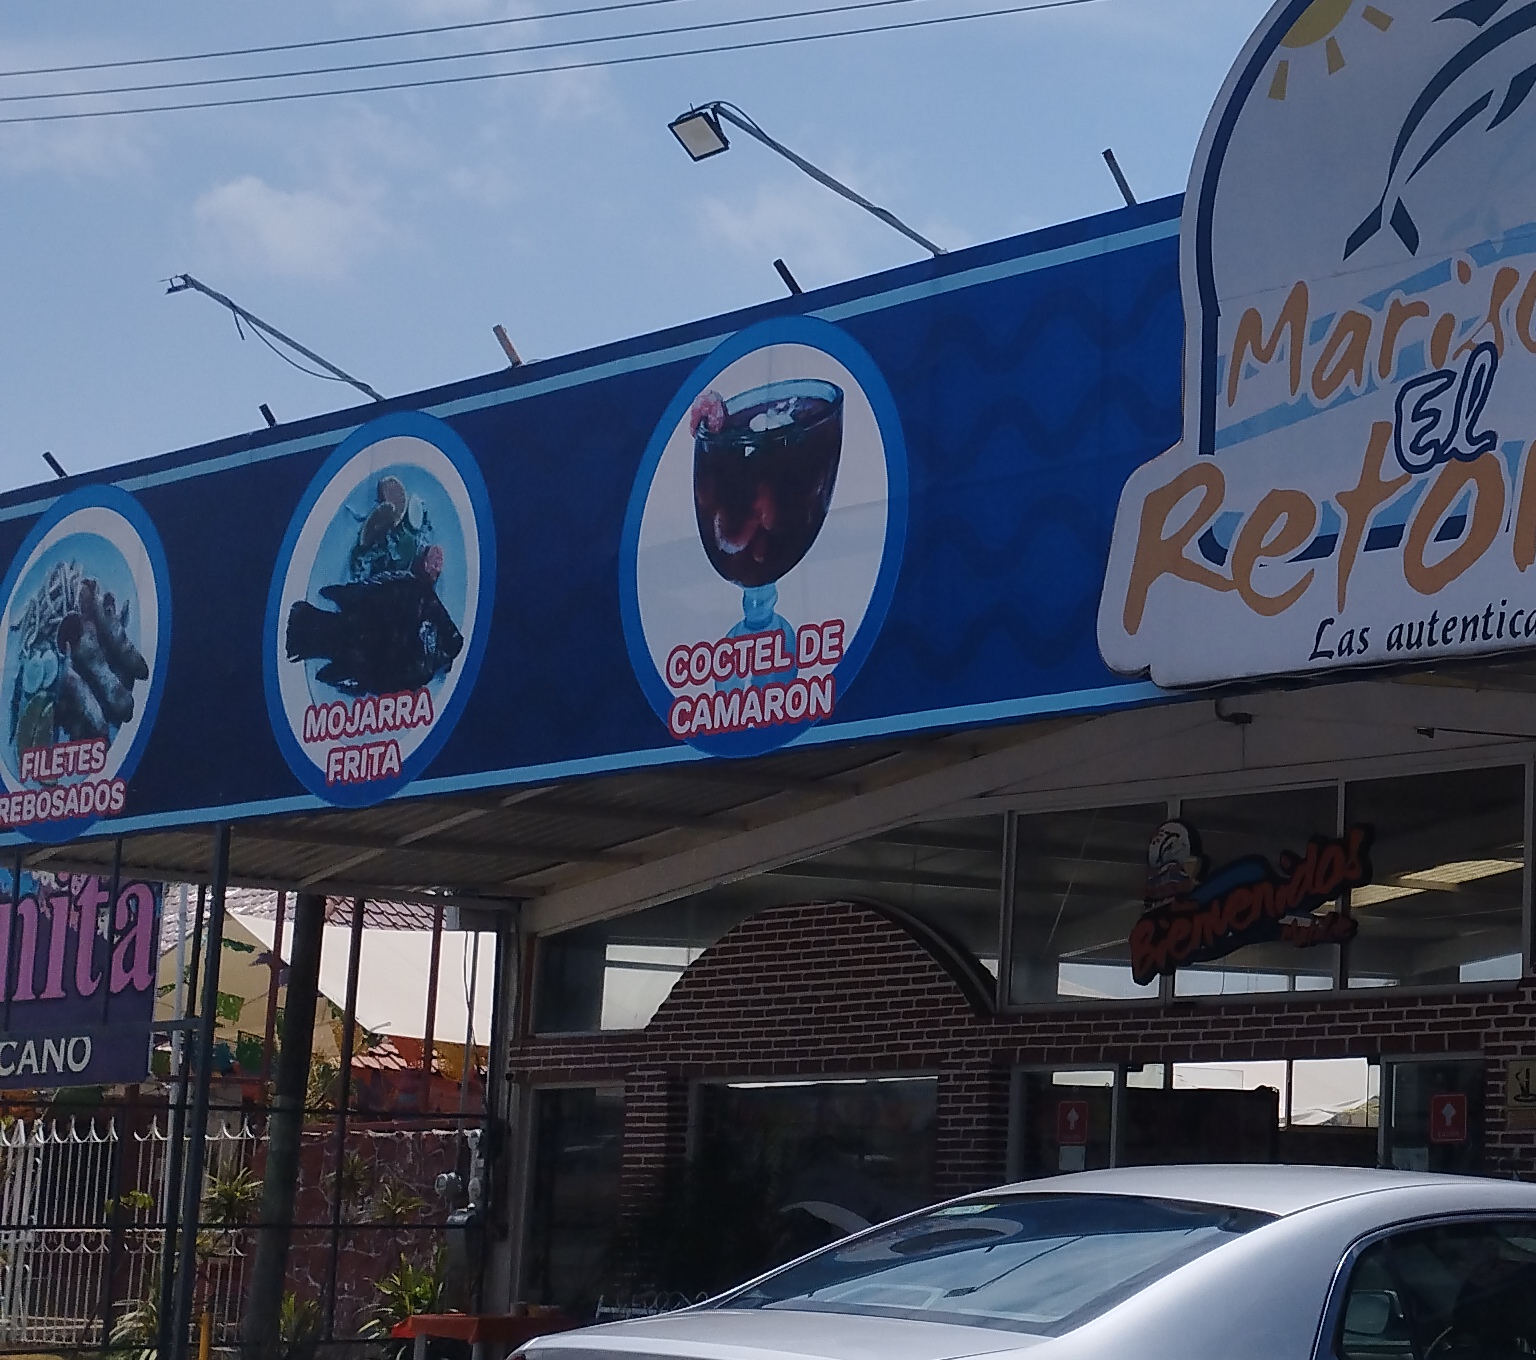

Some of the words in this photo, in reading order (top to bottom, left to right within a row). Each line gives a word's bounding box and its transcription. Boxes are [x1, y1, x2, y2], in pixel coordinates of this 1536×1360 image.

[669, 634, 790, 684] COCTEL
[799, 624, 842, 665] DE
[1308, 617, 1370, 660] Las
[307, 695, 432, 736] MOJARRA
[671, 679, 832, 734] CAMARON
[21, 742, 106, 778] FILETES
[328, 749, 399, 782] FRITA
[0, 782, 125, 823] REBOSADOS
